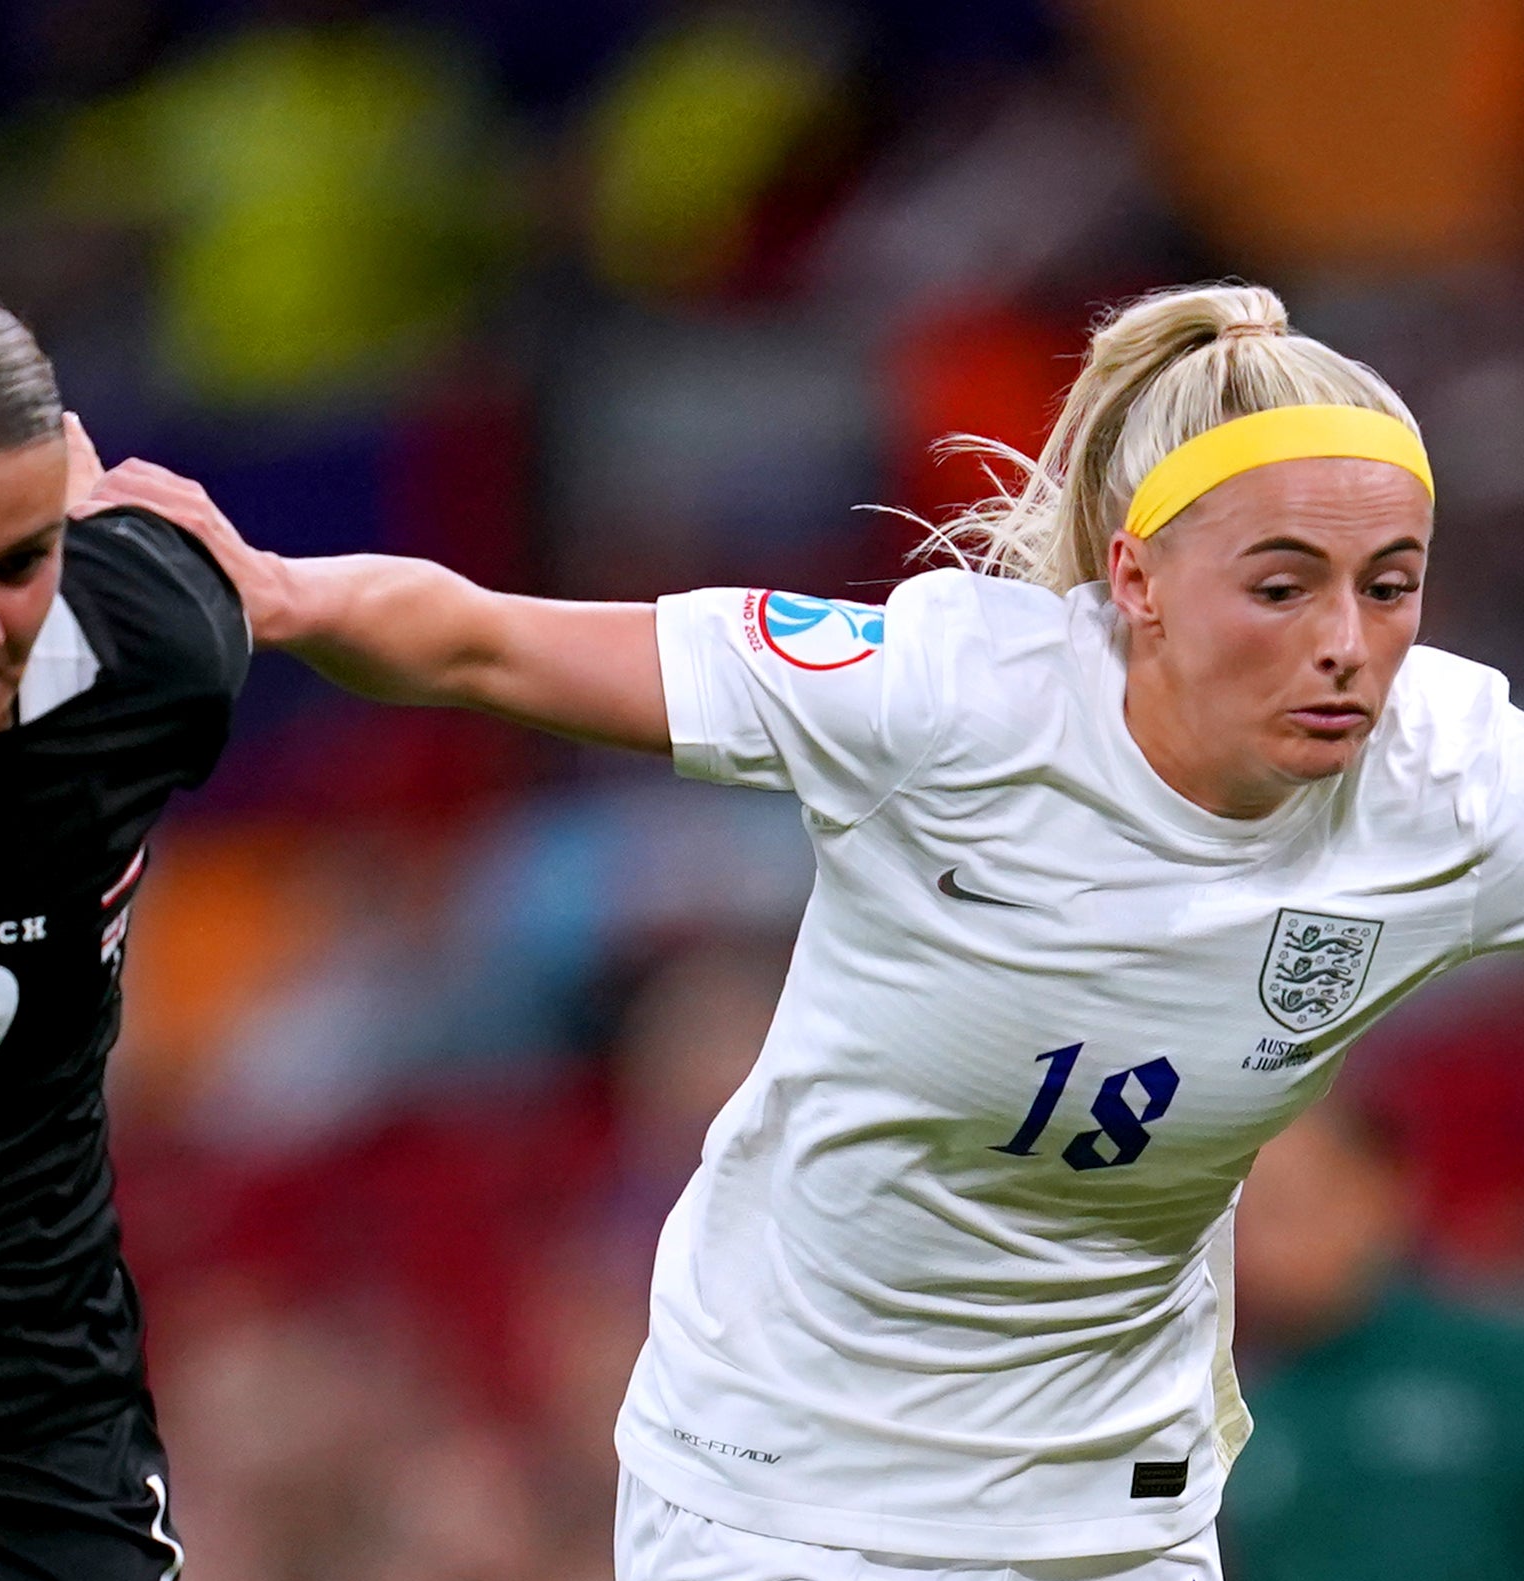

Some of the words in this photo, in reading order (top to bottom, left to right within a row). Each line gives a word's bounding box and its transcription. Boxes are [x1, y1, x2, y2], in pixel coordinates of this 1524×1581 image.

[744, 624, 764, 654] 2022
[1241, 1056, 1252, 1069] 6
[984, 1041, 1181, 1173] 18
